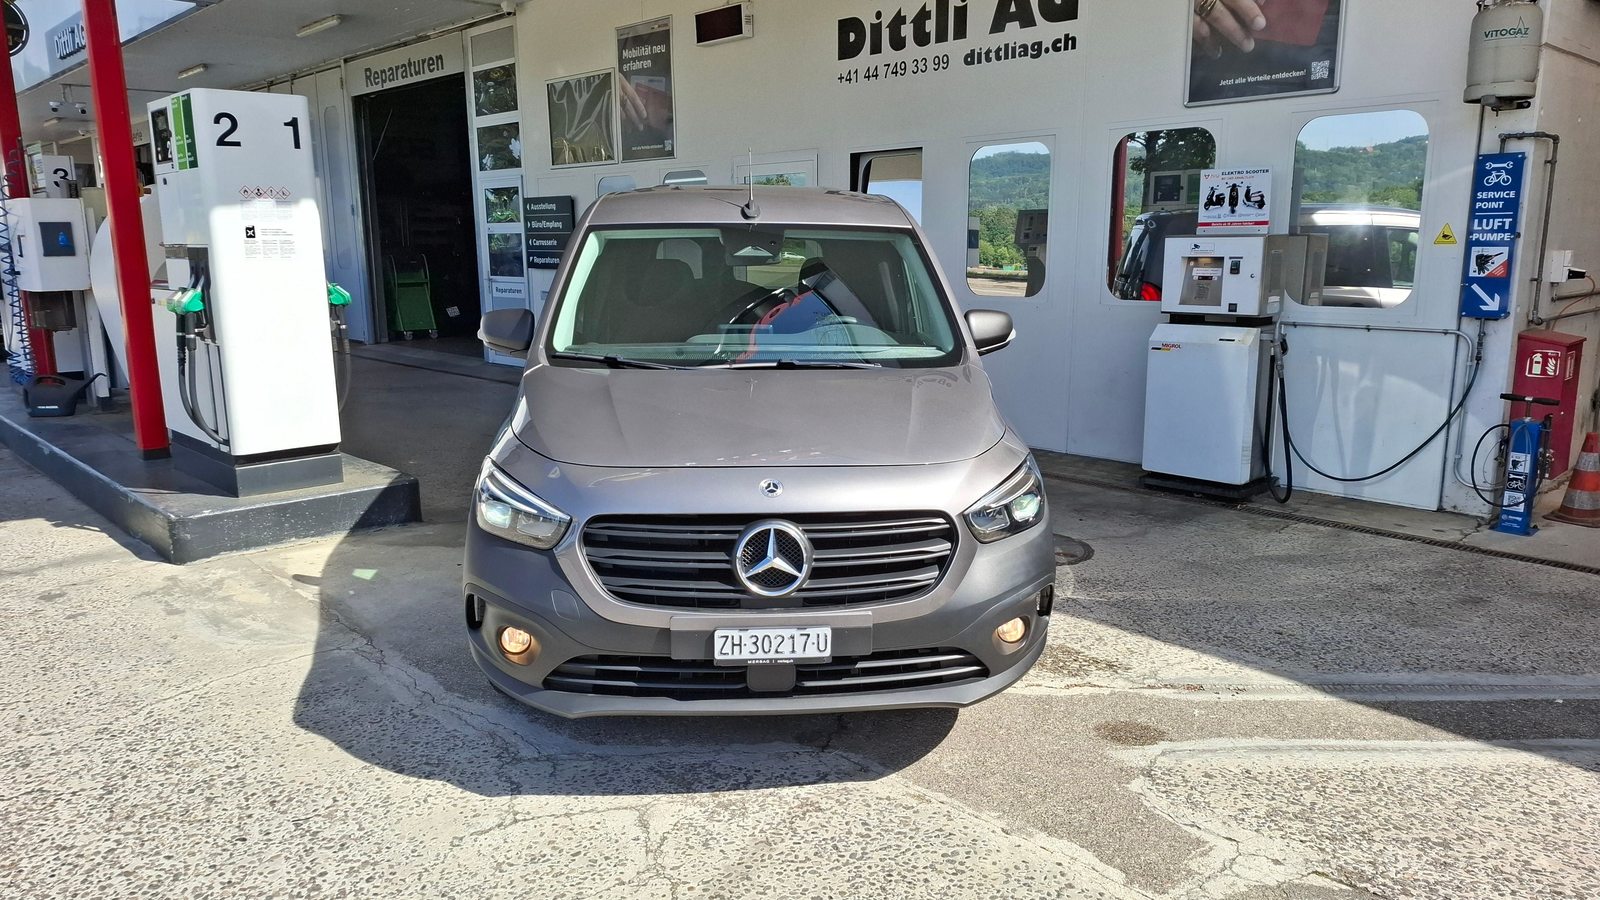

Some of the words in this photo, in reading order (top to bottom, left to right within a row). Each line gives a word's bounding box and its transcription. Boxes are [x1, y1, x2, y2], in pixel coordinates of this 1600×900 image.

[838, 0, 968, 61] Dittli
[54, 27, 74, 59] Dittli
[622, 44, 651, 59] Mobilität
[652, 44, 666, 54] neu
[838, 68, 859, 84] +41
[864, 65, 879, 81] 44
[883, 61, 907, 78] 749
[911, 57, 928, 74] 33
[932, 54, 950, 71] 99
[963, 33, 1077, 66] dittliag.ch
[364, 54, 444, 88] Reparaturen
[622, 60, 652, 72] erfahren
[1247, 74, 1271, 83] Vorteile
[1272, 69, 1307, 80] entdecken!
[213, 112, 242, 147] 2
[283, 117, 301, 150] 1
[1477, 190, 1516, 199] SERVICE
[1475, 201, 1505, 209] POINT
[1473, 218, 1513, 230] LUFT
